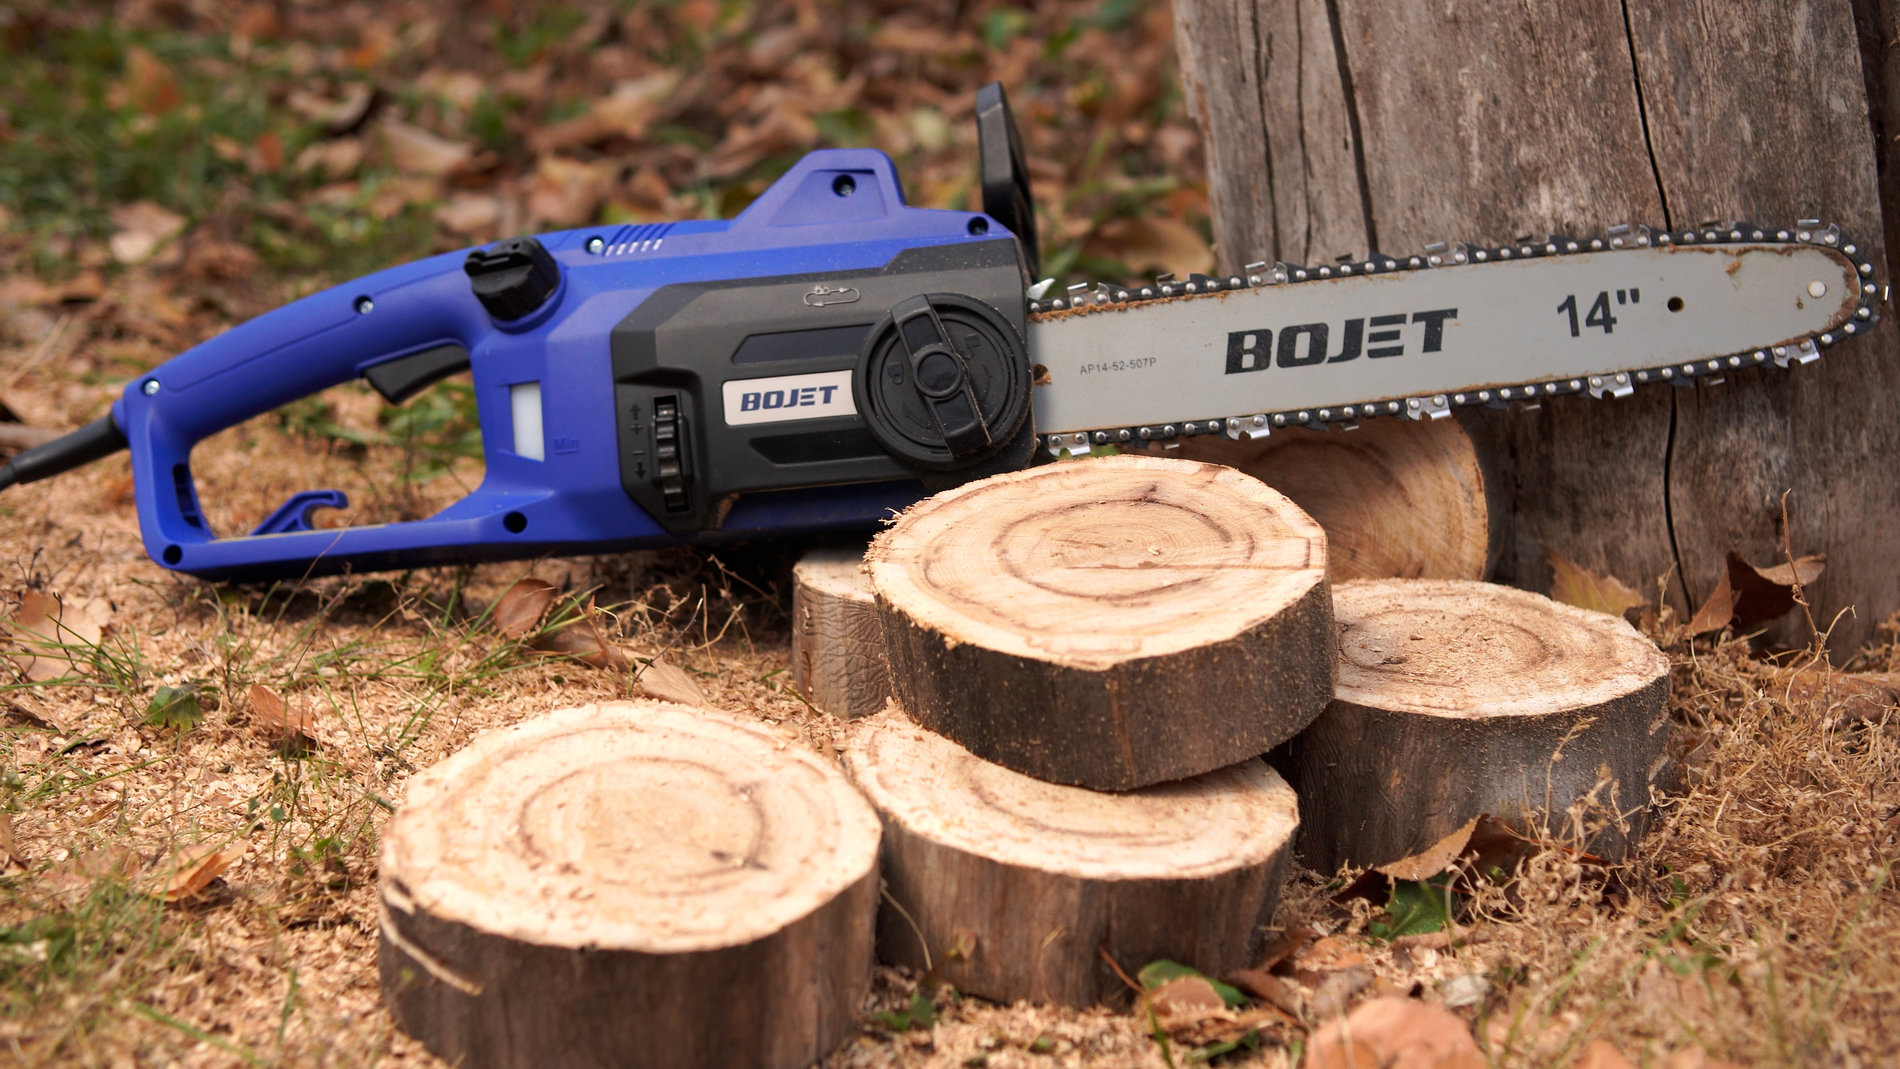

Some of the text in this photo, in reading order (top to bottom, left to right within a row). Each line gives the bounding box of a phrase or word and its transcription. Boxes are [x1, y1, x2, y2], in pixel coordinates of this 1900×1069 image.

[1557, 288, 1640, 337] 14"
[1225, 308, 1458, 374] BOJET
[1080, 357, 1157, 374] AP14-52-507P
[741, 385, 838, 411] BOJET
